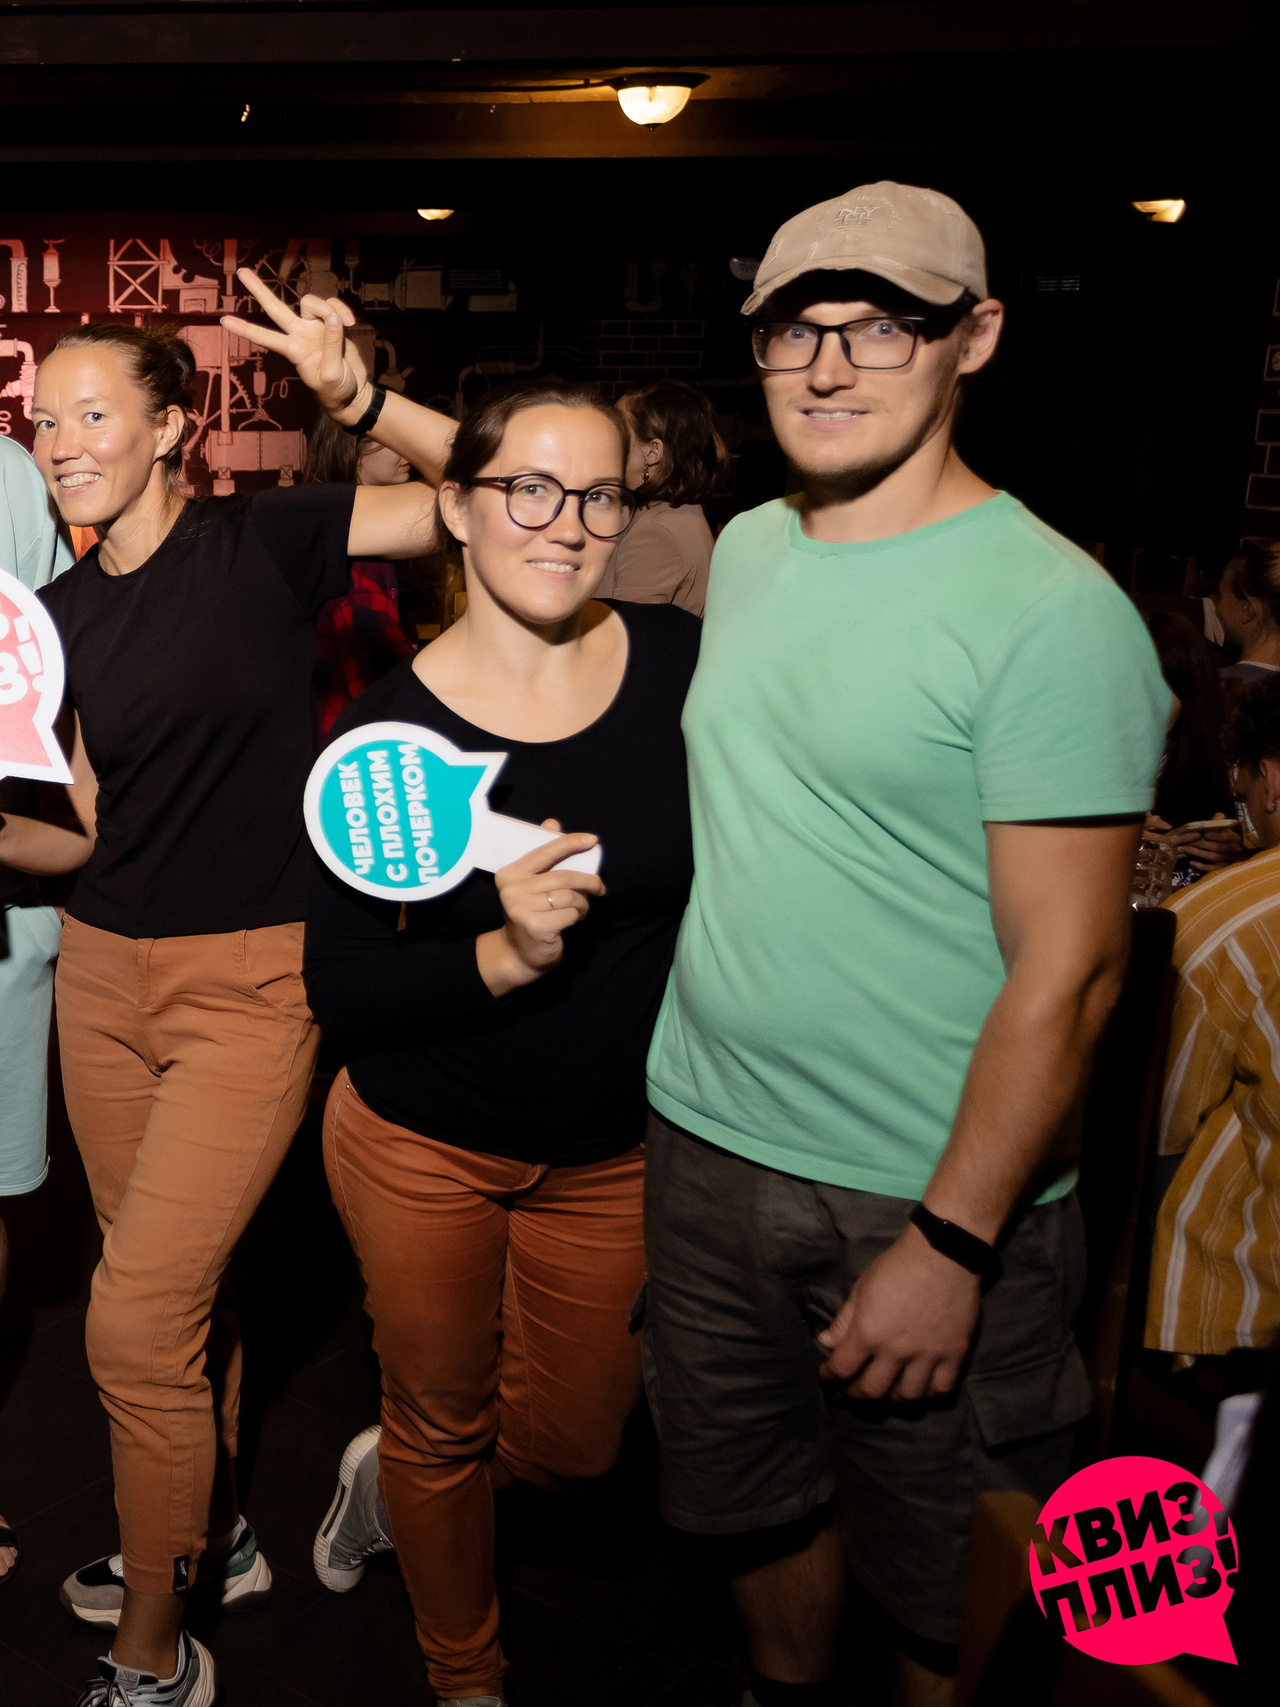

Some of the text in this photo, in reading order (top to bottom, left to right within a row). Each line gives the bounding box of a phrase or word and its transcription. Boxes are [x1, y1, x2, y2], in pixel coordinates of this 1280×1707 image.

[337, 761, 375, 875] ЧЕЛОВЕК
[366, 750, 408, 882] С ПЛОХИМ
[397, 743, 440, 884] ПОЧЕРКОМ
